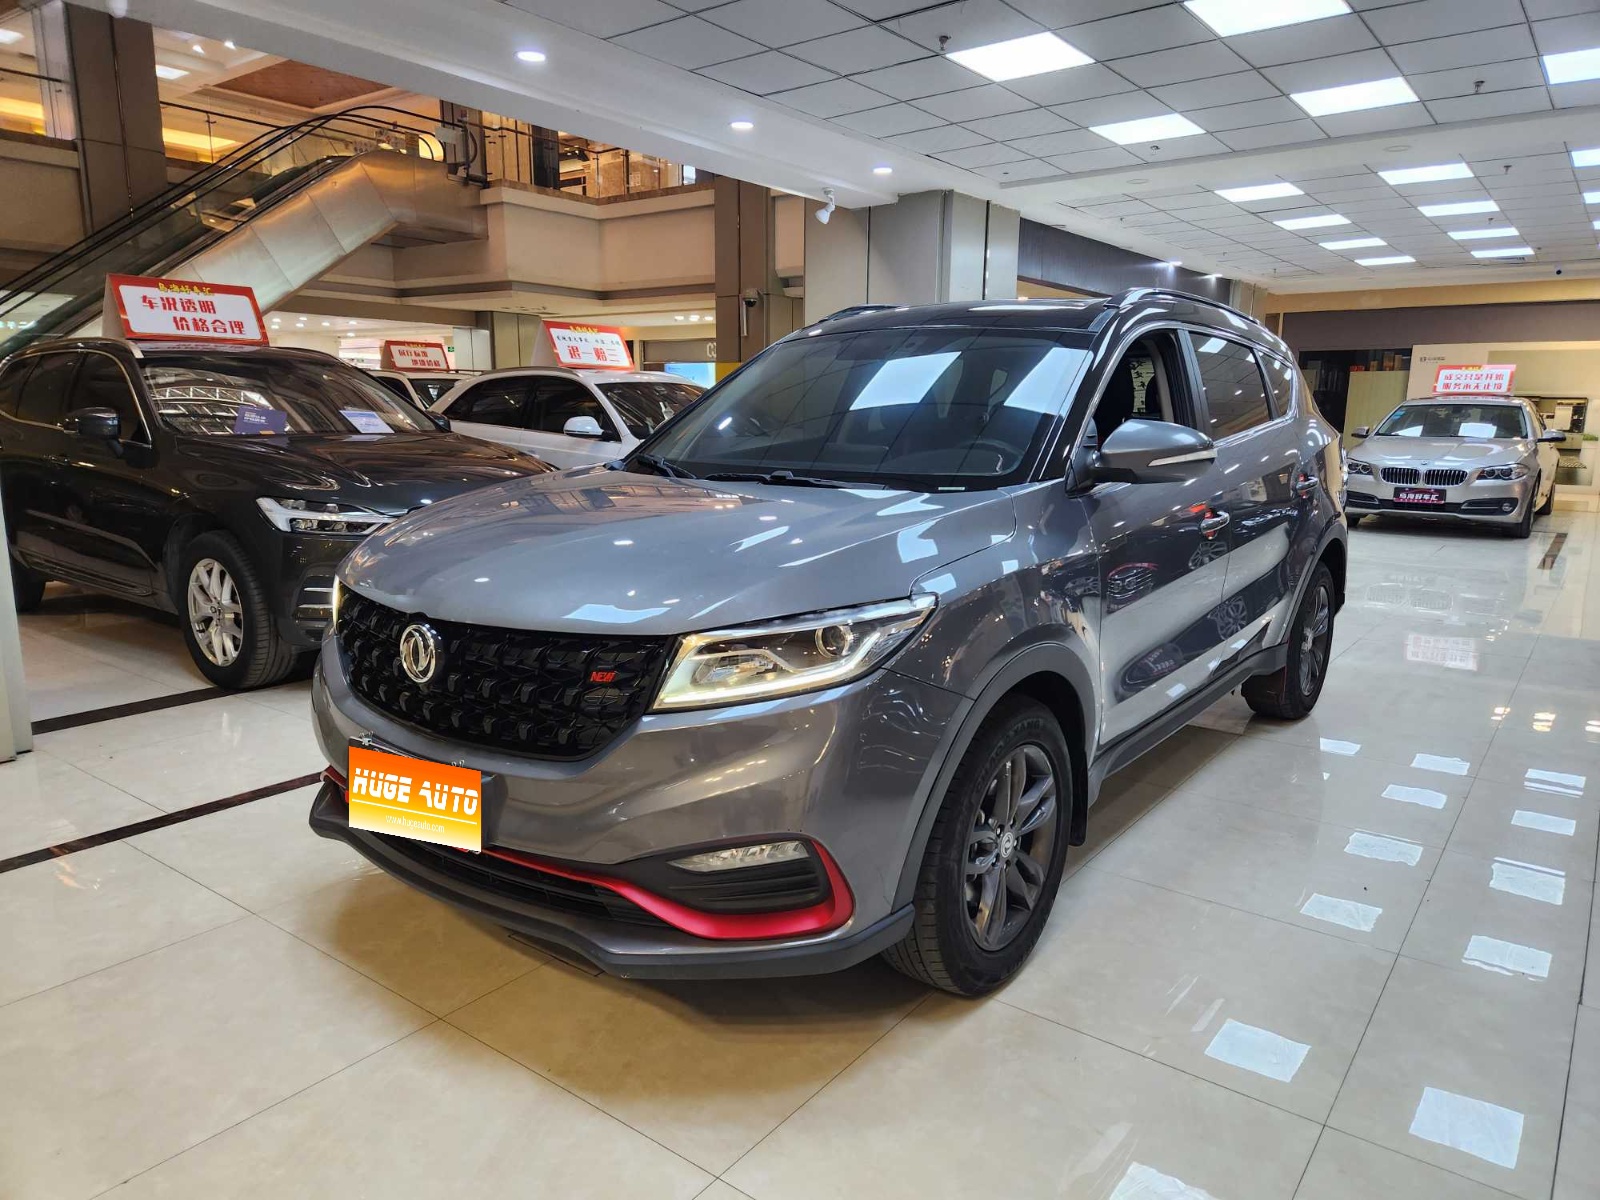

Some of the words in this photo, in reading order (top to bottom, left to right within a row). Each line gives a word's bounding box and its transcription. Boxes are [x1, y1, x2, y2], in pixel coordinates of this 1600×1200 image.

[141, 294, 217, 315] 车况透明
[172, 315, 246, 336] 价格合理
[589, 671, 617, 683] NEW
